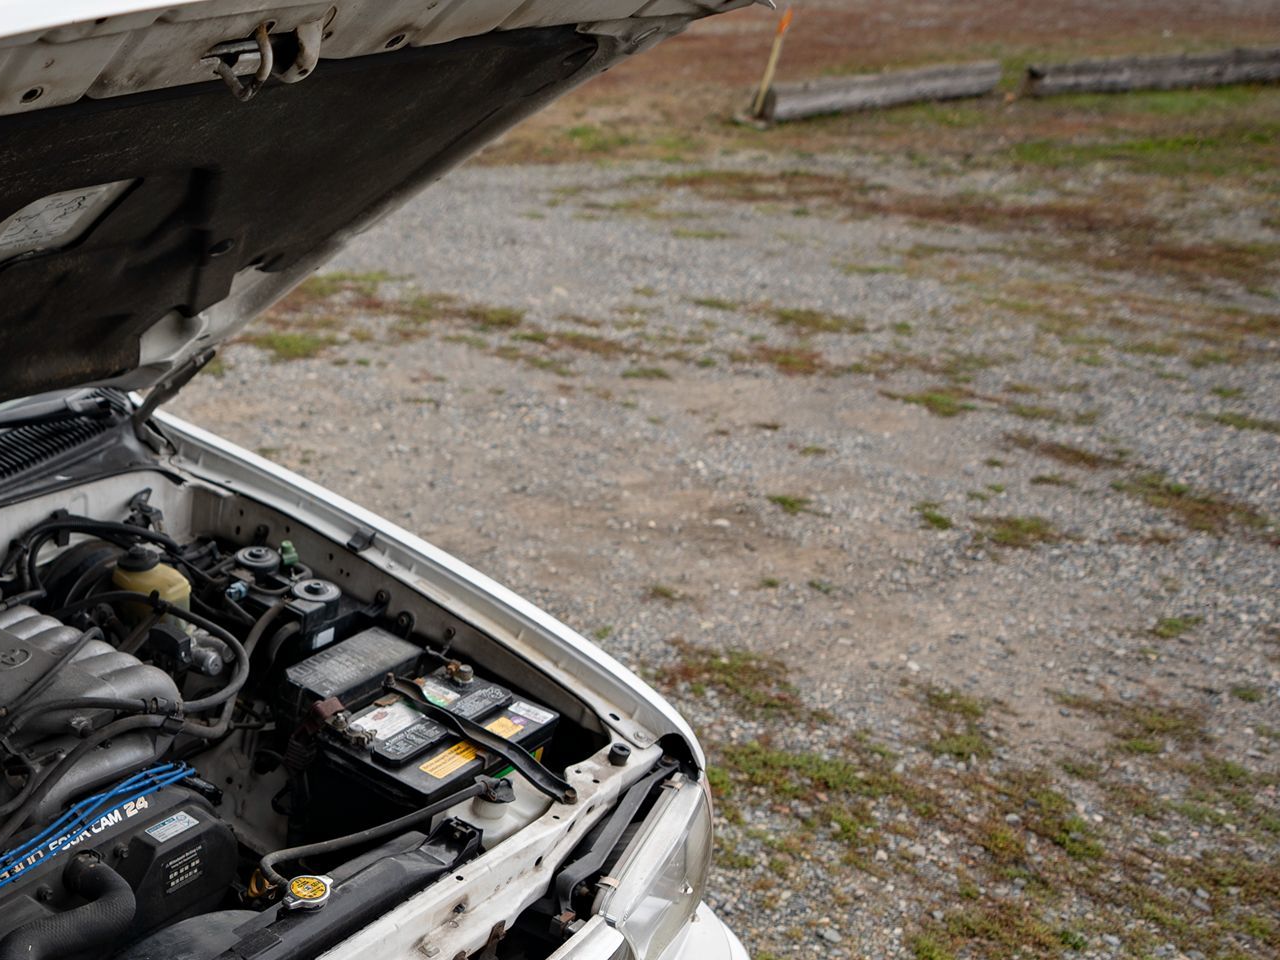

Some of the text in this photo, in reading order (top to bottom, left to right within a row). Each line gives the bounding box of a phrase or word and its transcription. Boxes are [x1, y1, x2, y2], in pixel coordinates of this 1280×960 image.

[48, 825, 93, 857] FOUR
[91, 808, 123, 835] CAM
[123, 796, 149, 818] 24
